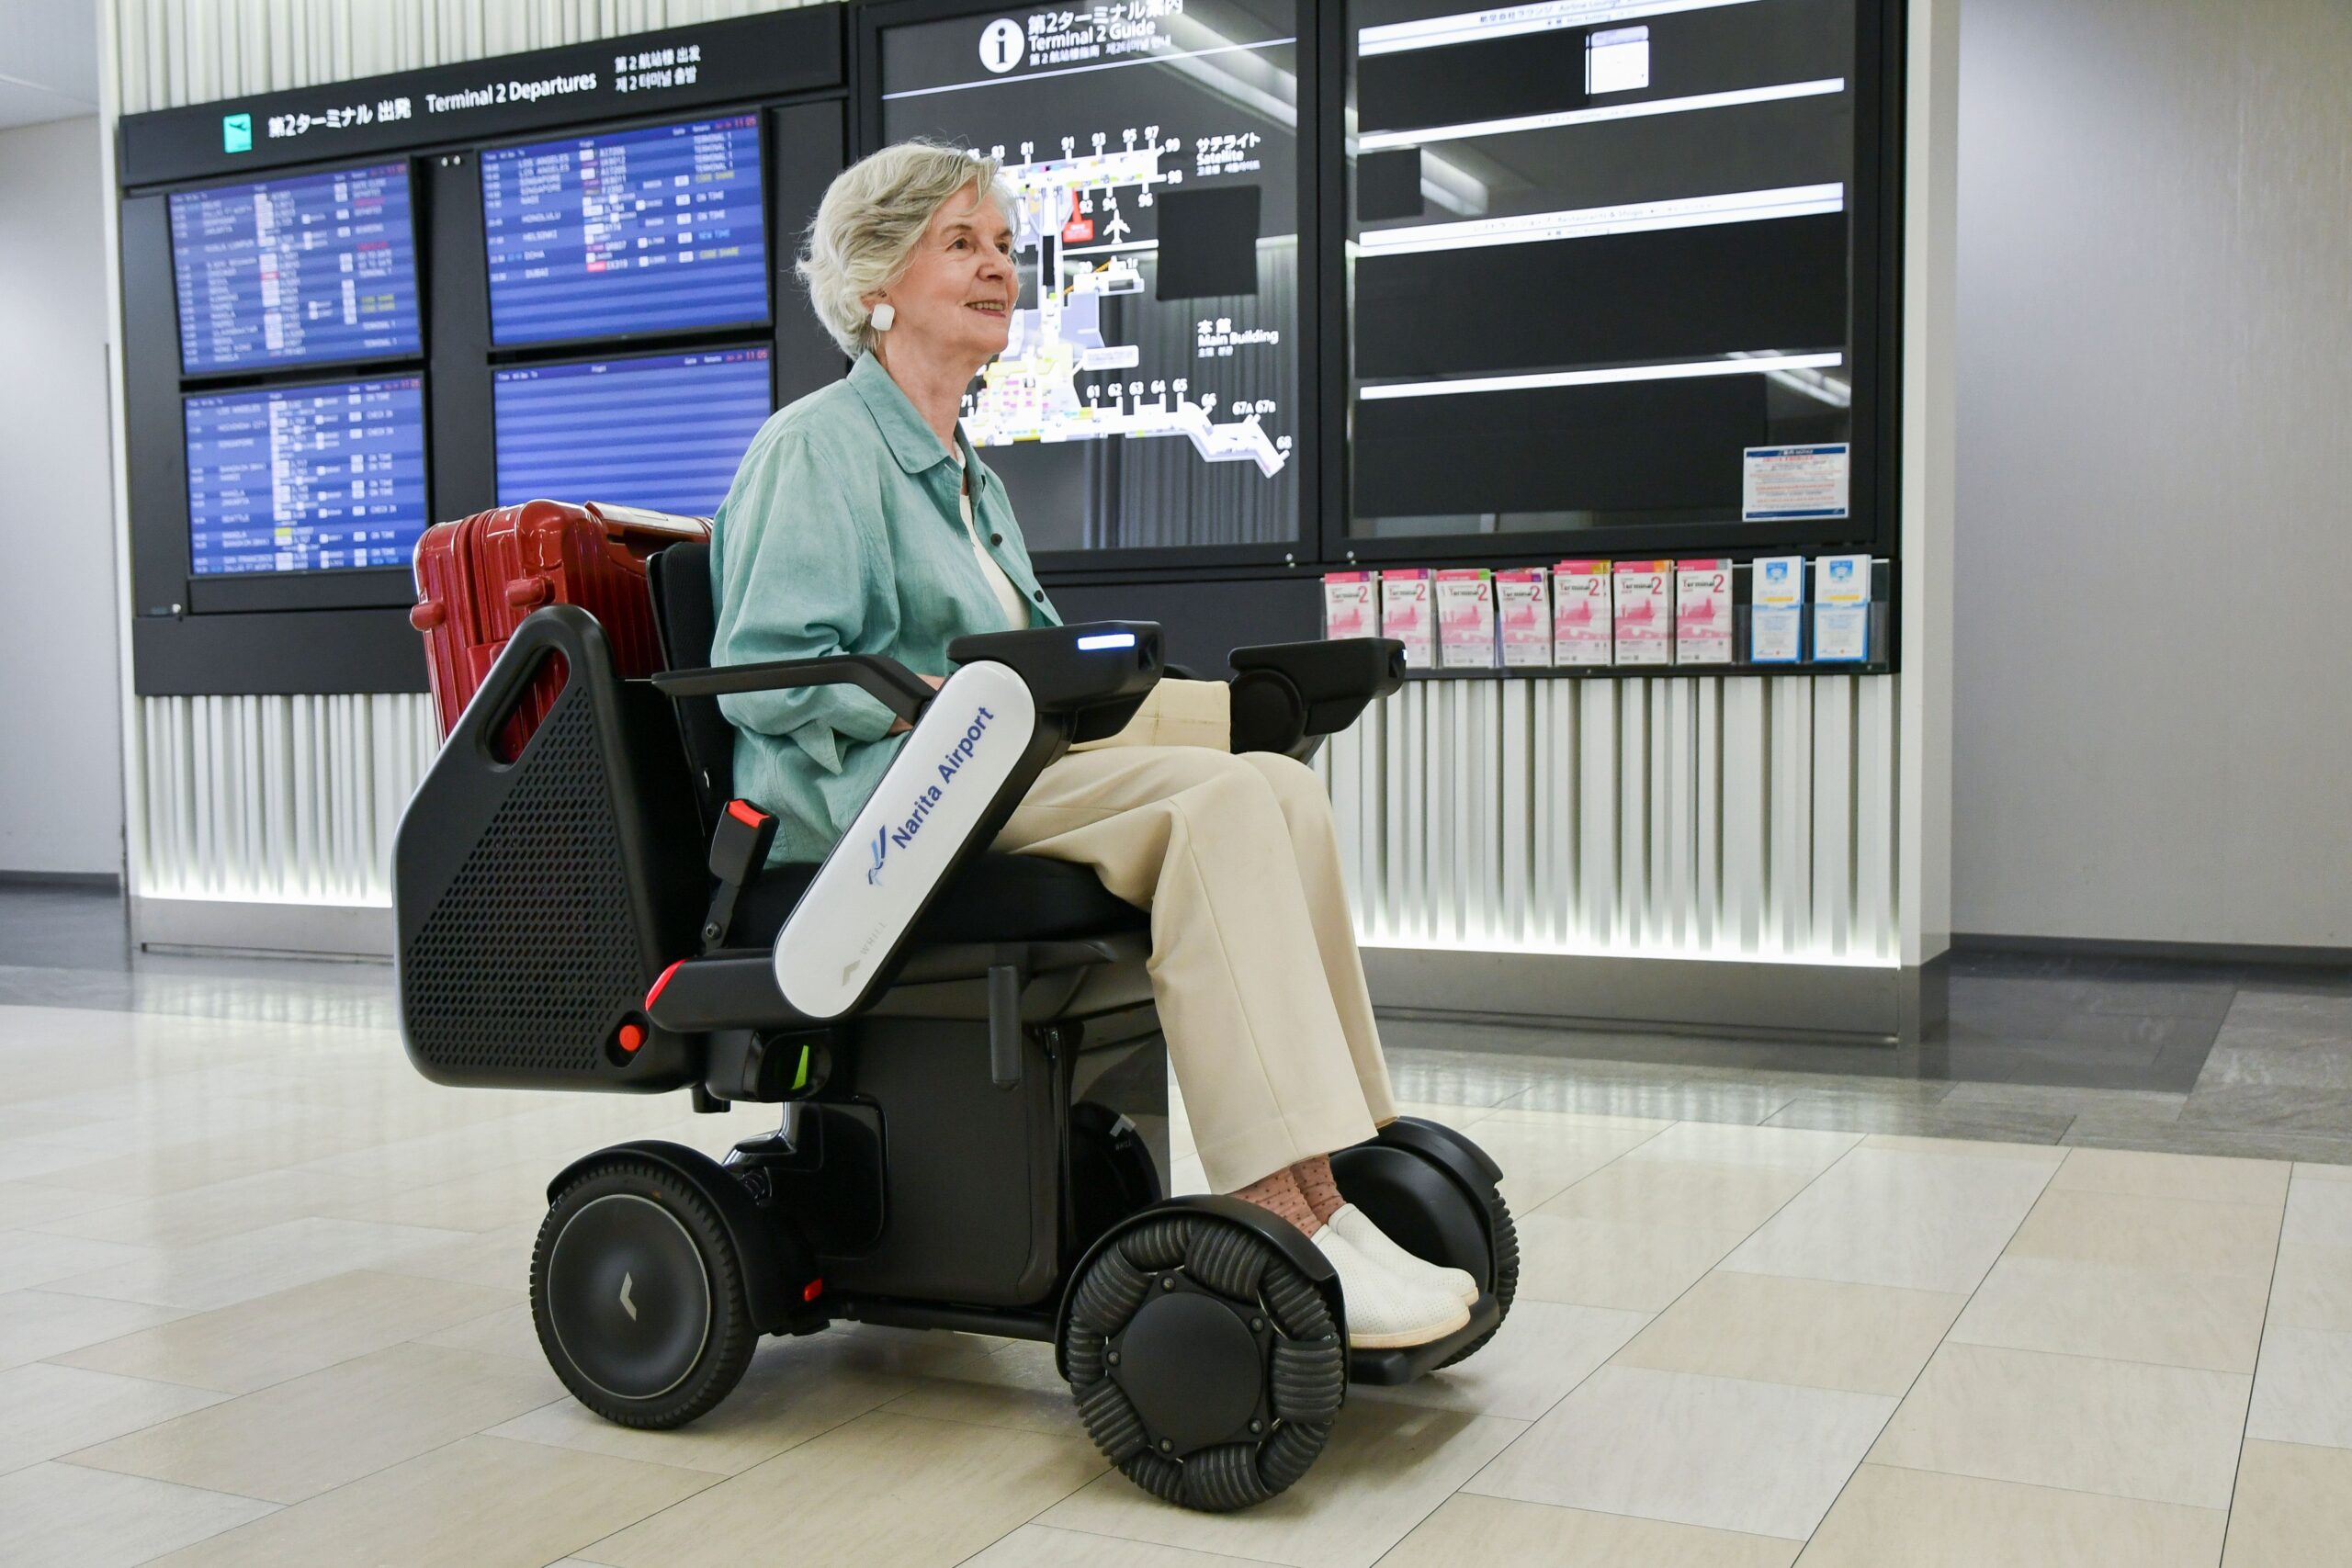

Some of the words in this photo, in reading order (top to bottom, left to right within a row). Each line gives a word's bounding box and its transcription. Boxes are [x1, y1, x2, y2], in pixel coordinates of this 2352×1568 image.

[1028, 0, 1184, 36] 第2ターミナル案内
[1029, 26, 1093, 52] Terminal
[1096, 25, 1106, 42] 2
[1109, 18, 1157, 40] Guide
[425, 84, 493, 114] Terminal
[495, 83, 506, 104] 2
[509, 72, 598, 103] Departures
[268, 105, 374, 138] 第2ターミナル
[378, 96, 412, 122] 出発
[1091, 131, 1106, 147] 93
[1123, 128, 1137, 143] 95
[1145, 125, 1159, 141] 97
[1061, 136, 1074, 151] 91
[1196, 131, 1261, 153] サテライト
[1196, 149, 1244, 166] Satellite
[1080, 199, 1093, 214] 92
[1102, 197, 1117, 212] 94
[1138, 193, 1153, 208] 96
[1198, 333, 1228, 347] Main
[1229, 329, 1279, 345] Building
[1086, 384, 1101, 399] 61
[1107, 383, 1123, 397] 62
[1129, 381, 1144, 396] 63
[1150, 379, 1166, 394] 64
[1172, 378, 1188, 392] 65
[1201, 392, 1216, 407] 66
[1232, 400, 1254, 415] 67A
[1276, 435, 1293, 450] 68
[1415, 583, 1426, 601] 2
[1449, 587, 1479, 597] Terminal
[1476, 583, 1488, 601] 2
[1560, 580, 1590, 592] Terminal
[1589, 579, 1600, 596] 2
[1622, 579, 1653, 590] Terminal
[1651, 576, 1663, 594] 2
[1683, 577, 1715, 589] Terminal
[1713, 574, 1724, 593] 2
[1358, 585, 1369, 603] 2
[1503, 585, 1532, 597] Terminal
[1530, 585, 1543, 602] 2
[891, 784, 943, 849] Narita
[937, 705, 995, 784] Airport
[859, 921, 888, 955] WHILL
